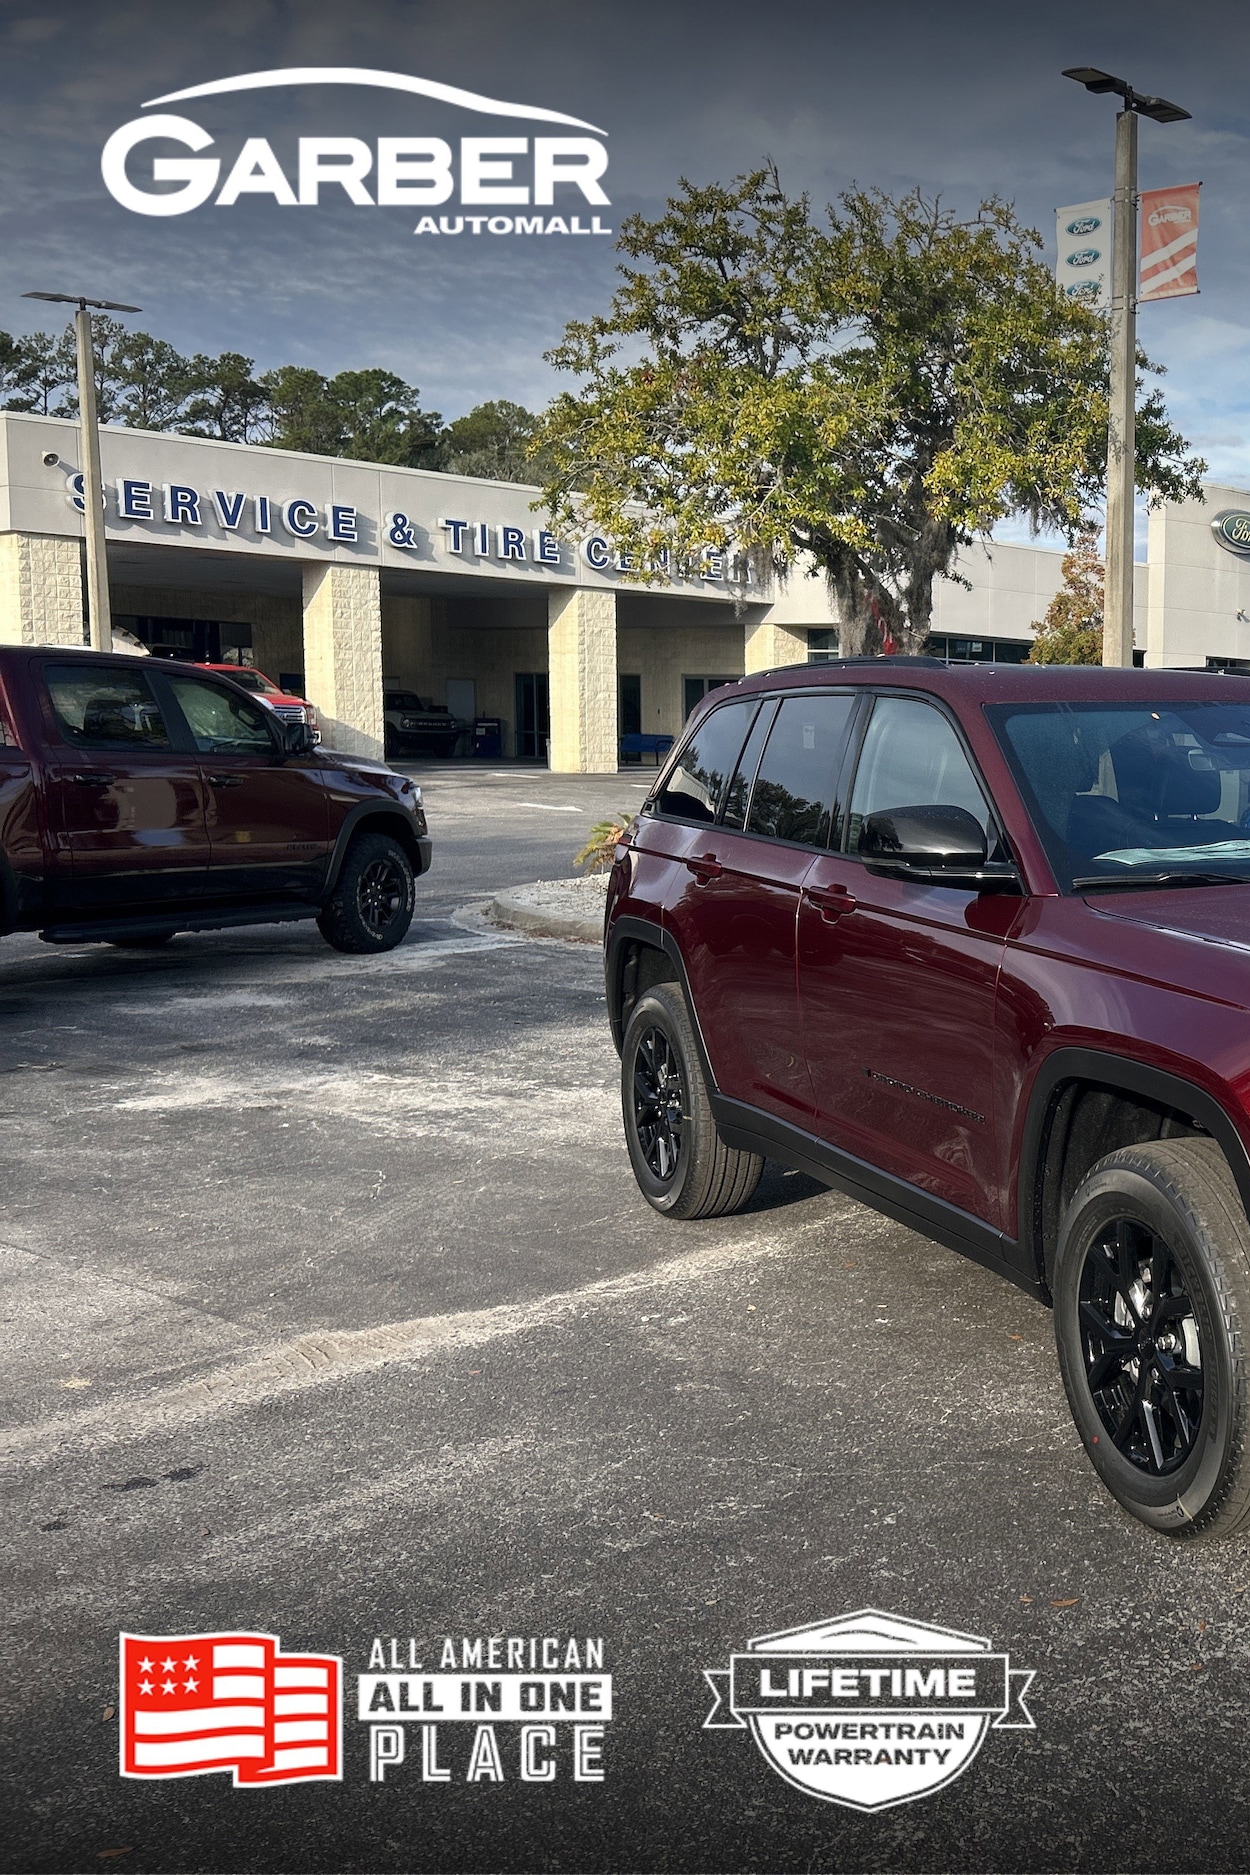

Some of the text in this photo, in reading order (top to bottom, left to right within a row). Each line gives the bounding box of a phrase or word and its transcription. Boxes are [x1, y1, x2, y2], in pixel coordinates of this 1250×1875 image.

[1072, 220, 1095, 234] Ford
[1072, 251, 1095, 265] Ford
[385, 512, 418, 551] &
[438, 517, 561, 565] TIRE
